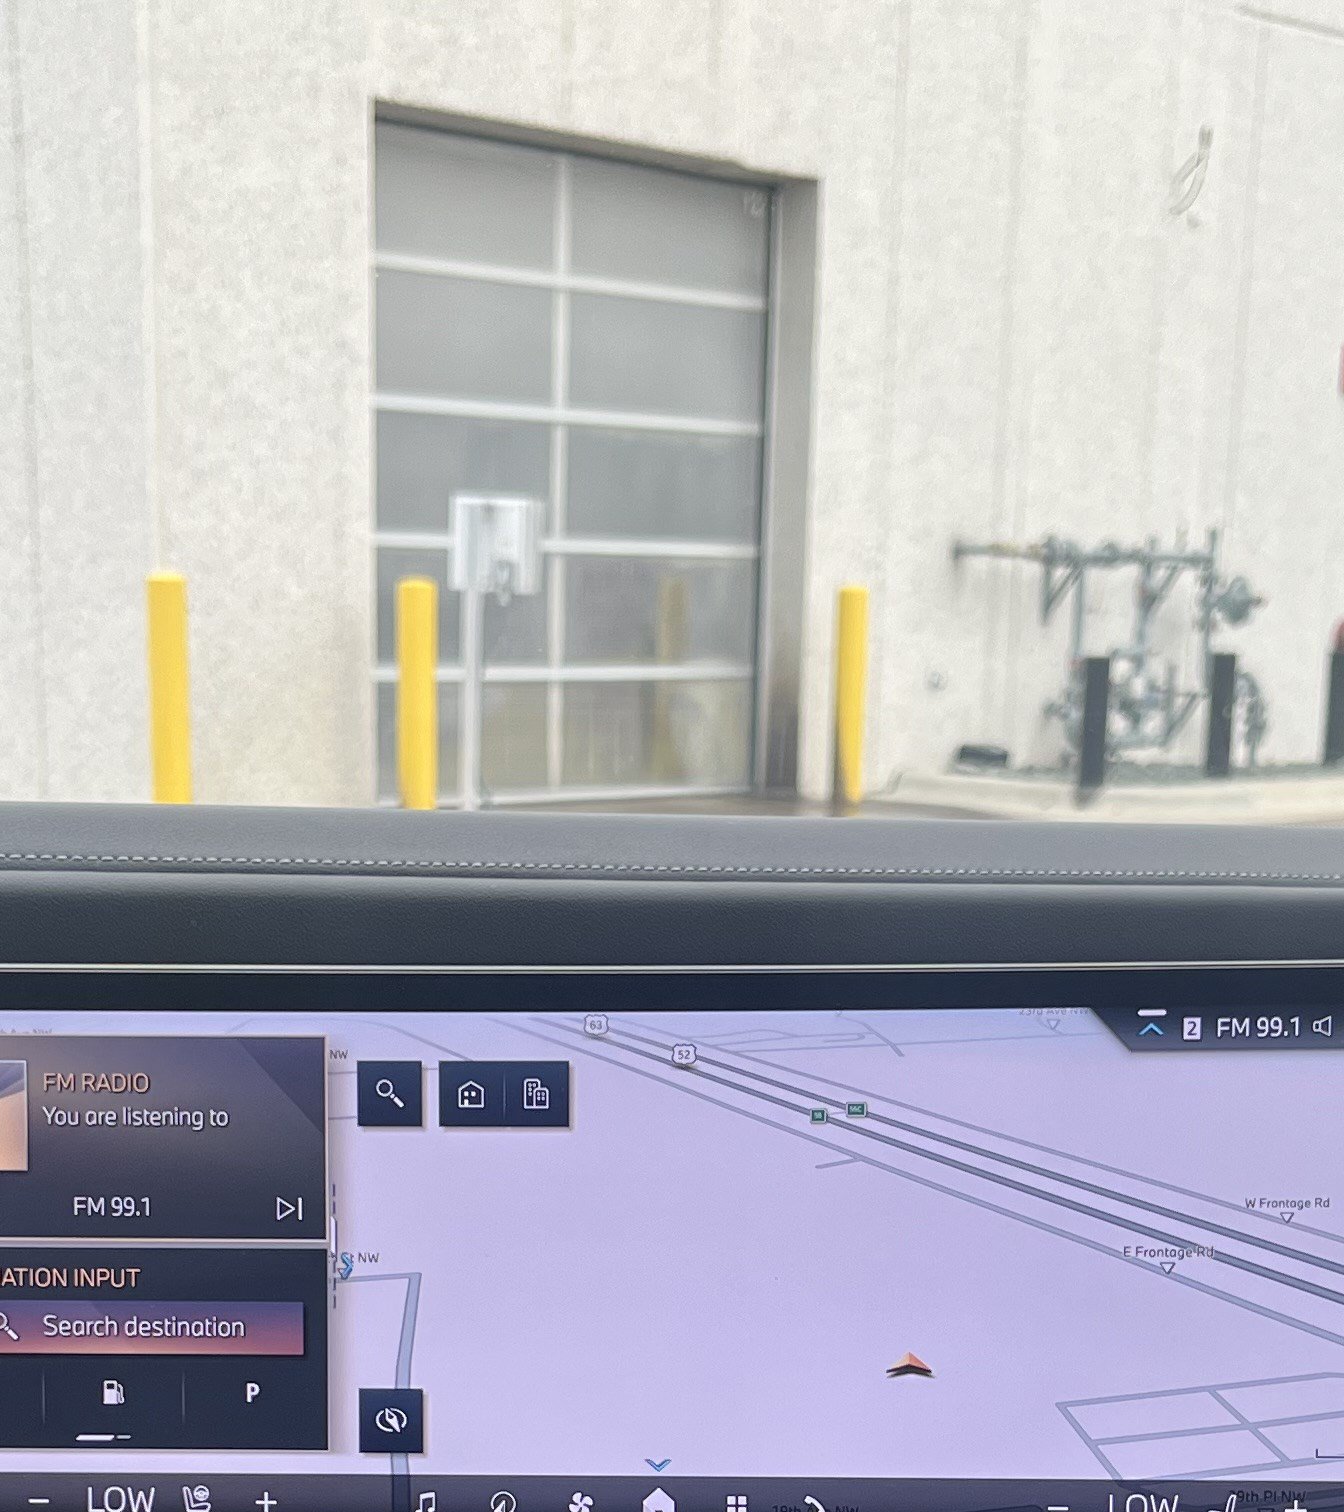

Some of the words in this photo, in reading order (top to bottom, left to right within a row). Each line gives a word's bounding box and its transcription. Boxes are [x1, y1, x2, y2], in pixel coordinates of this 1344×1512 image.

[590, 1020, 602, 1030] 63
[1217, 1018, 1250, 1038] FM
[1256, 1018, 1300, 1038] 99.1
[678, 1050, 690, 1060] 52
[43, 1073, 75, 1092] FM
[82, 1073, 149, 1093] RADIO
[43, 1106, 80, 1126] You
[85, 1109, 117, 1126] are
[123, 1107, 204, 1131] listening
[209, 1108, 229, 1127] to
[73, 1197, 105, 1217] FM
[110, 1196, 151, 1217] 99.1
[1245, 1198, 1256, 1208] W
[1260, 1197, 1311, 1211] Frontage
[1315, 1197, 1330, 1209] Rd
[358, 1253, 379, 1263] NW
[1124, 1246, 1131, 1257] E
[1135, 1246, 1193, 1260] Frontage
[1196, 1246, 1214, 1259] Rd
[74, 1267, 140, 1288] INPUT
[43, 1314, 118, 1337] Search
[125, 1316, 245, 1337] destination
